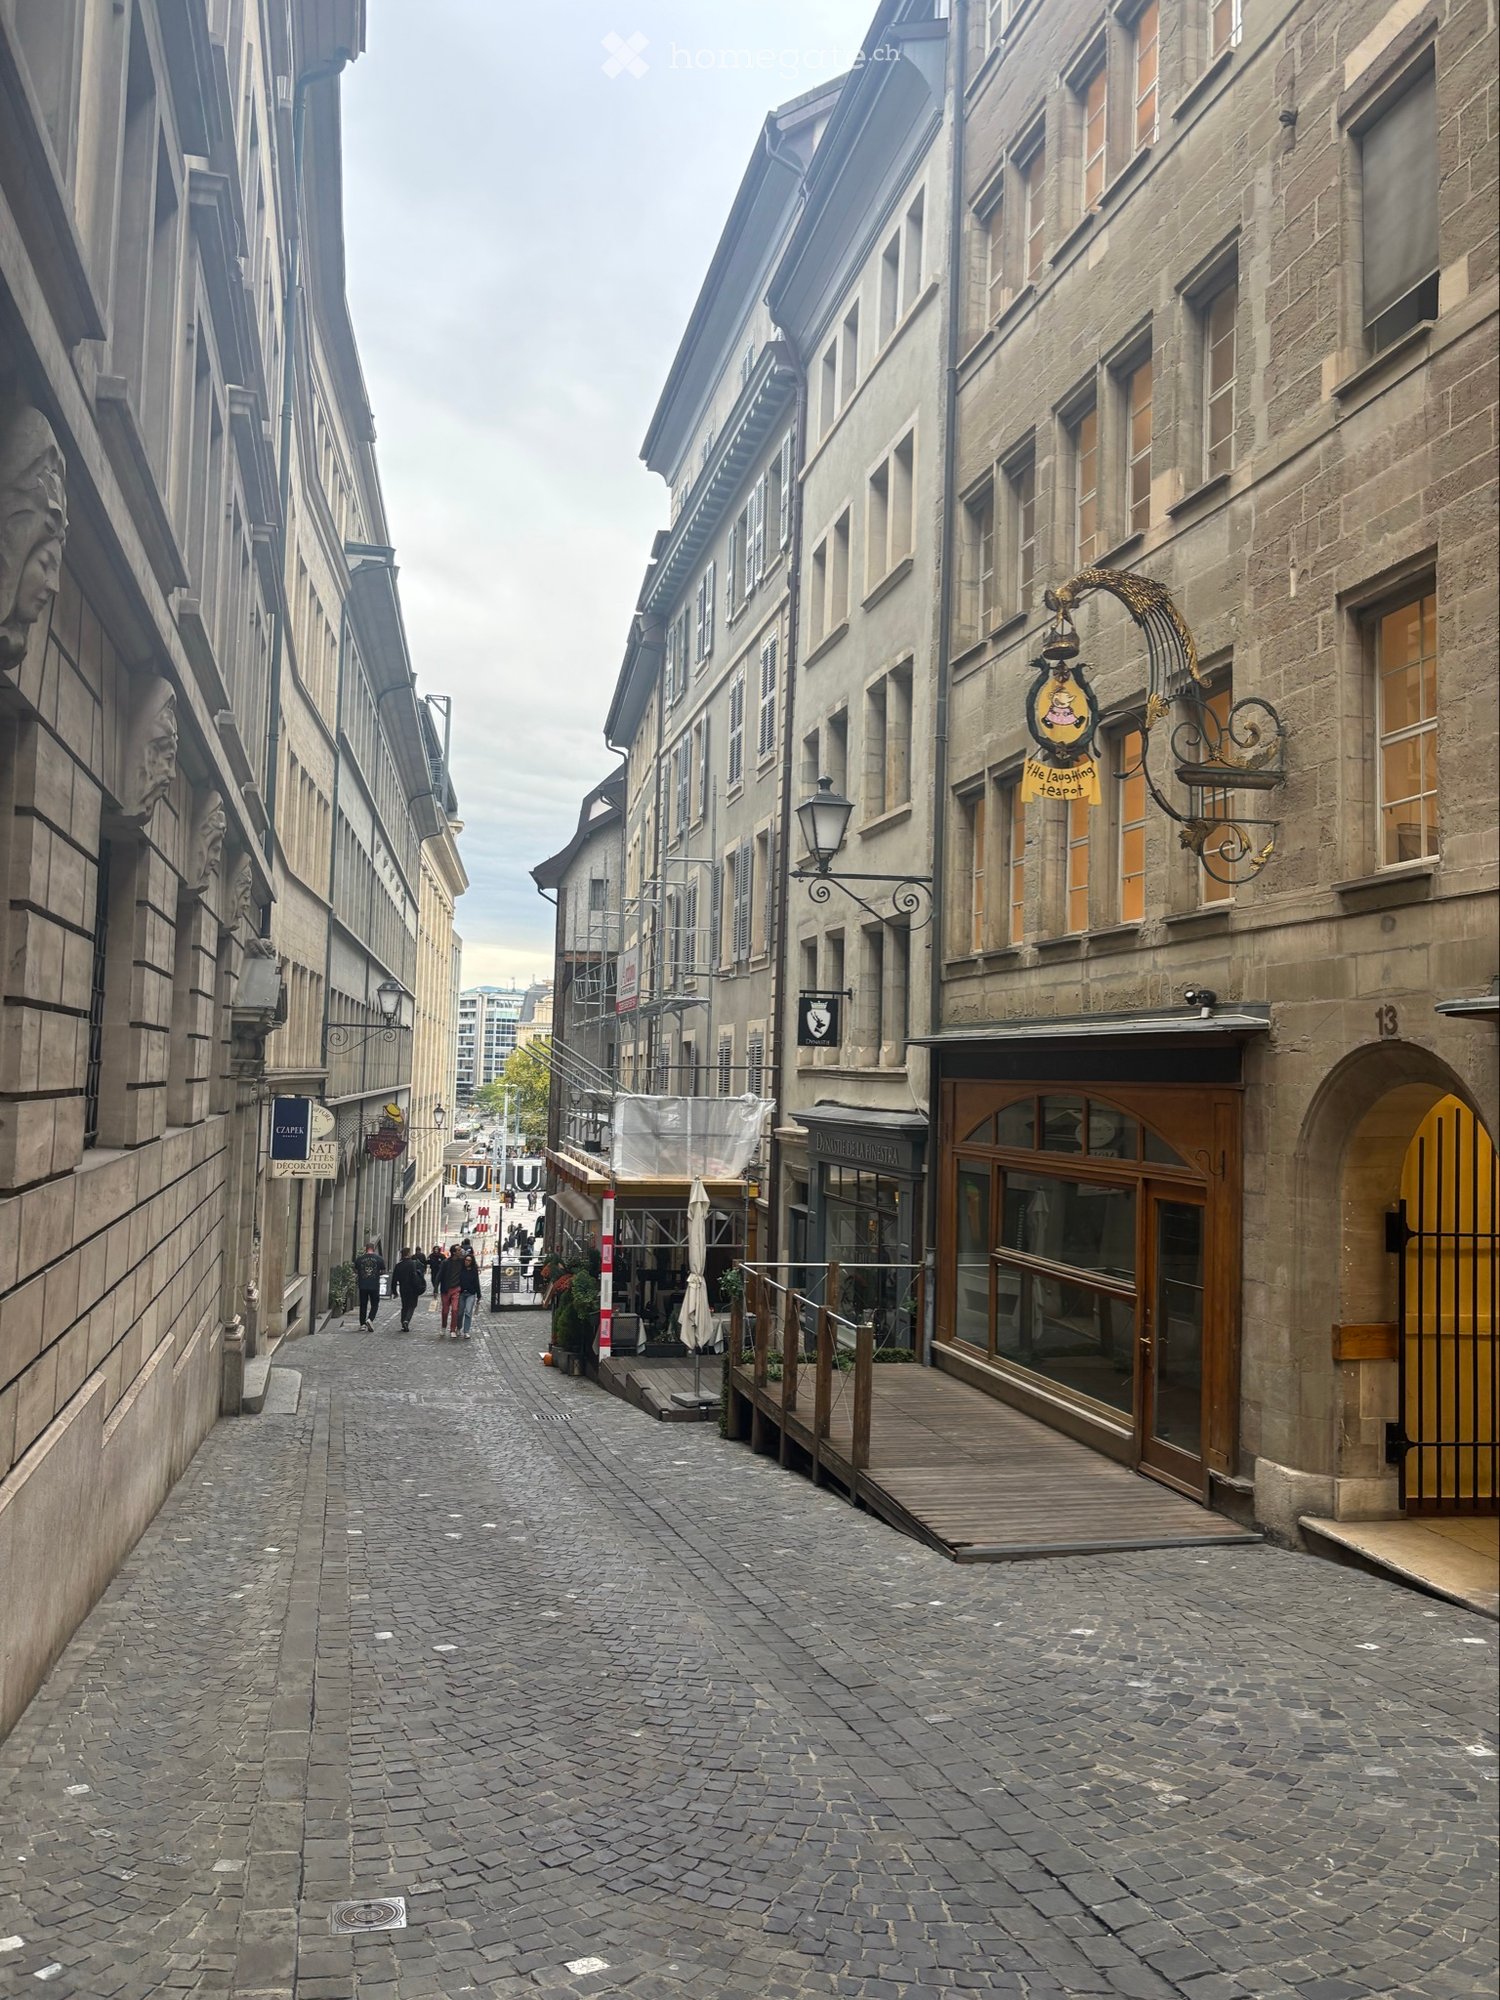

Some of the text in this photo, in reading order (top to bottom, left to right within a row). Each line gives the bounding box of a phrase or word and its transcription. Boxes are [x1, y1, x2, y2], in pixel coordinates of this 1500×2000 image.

[1040, 784, 1083, 800] teapot
[1375, 1004, 1398, 1035] 13
[276, 1126, 304, 1134] CZAPEK
[276, 1161, 334, 1170] DÉCORATION
